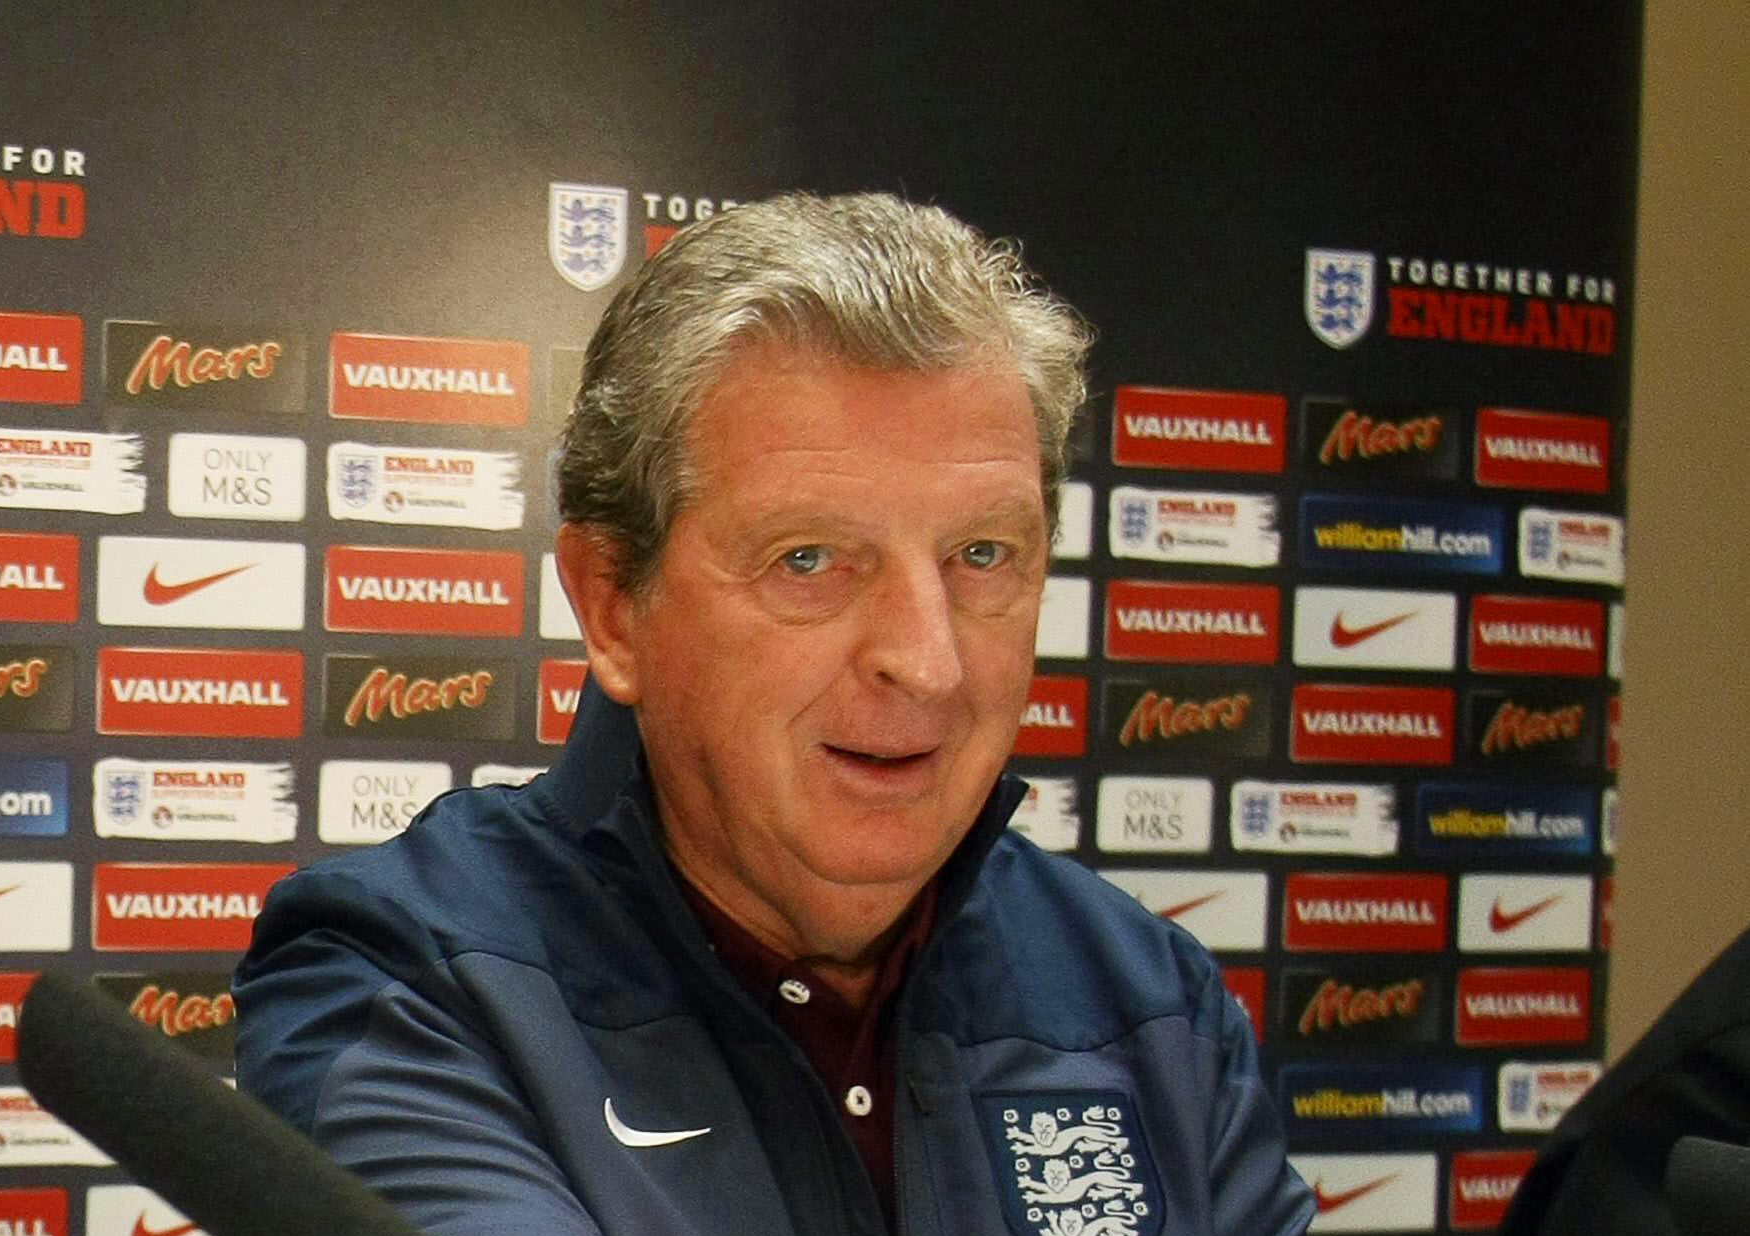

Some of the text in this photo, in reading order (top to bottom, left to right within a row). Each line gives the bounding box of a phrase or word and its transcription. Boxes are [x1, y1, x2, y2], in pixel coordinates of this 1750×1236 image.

[4, 147, 85, 177] FOR
[1388, 257, 1616, 303] TOGETHER FOR
[1388, 287, 1616, 356] ENGLAND
[126, 335, 283, 395] Mars
[343, 363, 514, 395] VAUXHALL
[1124, 414, 1273, 445] VAUXHALL
[1319, 410, 1444, 466] Mars
[203, 447, 273, 472] ONLY
[384, 456, 474, 475] ENGLAND
[1484, 436, 1602, 467] VAUXHALL
[202, 476, 272, 506] M&S
[1314, 523, 1492, 556] williamhill.com
[337, 575, 508, 607] VAUXHALL
[1115, 607, 1266, 637] VAUXHALL
[1479, 621, 1596, 652] VAUXHALL
[111, 677, 288, 707] VAUXHALL
[344, 666, 493, 727] Mars
[1119, 690, 1249, 747] Mars
[1302, 710, 1442, 739] VAUXHALL
[1482, 701, 1583, 756] Mars
[154, 772, 244, 787] ENGLAND
[353, 774, 418, 796] ONLY
[1124, 788, 1183, 810] ONLY
[352, 804, 414, 830] M&S
[1122, 815, 1184, 841] M&S
[1428, 809, 1585, 840] williamhill.com
[106, 893, 260, 920] VAUXHAL
[1296, 898, 1436, 926] VAUXHALL
[131, 986, 235, 1034] Mar
[1299, 978, 1424, 1035] Mars
[1465, 993, 1580, 1019] VAUXHALL
[1293, 1090, 1472, 1119] williamhill.com
